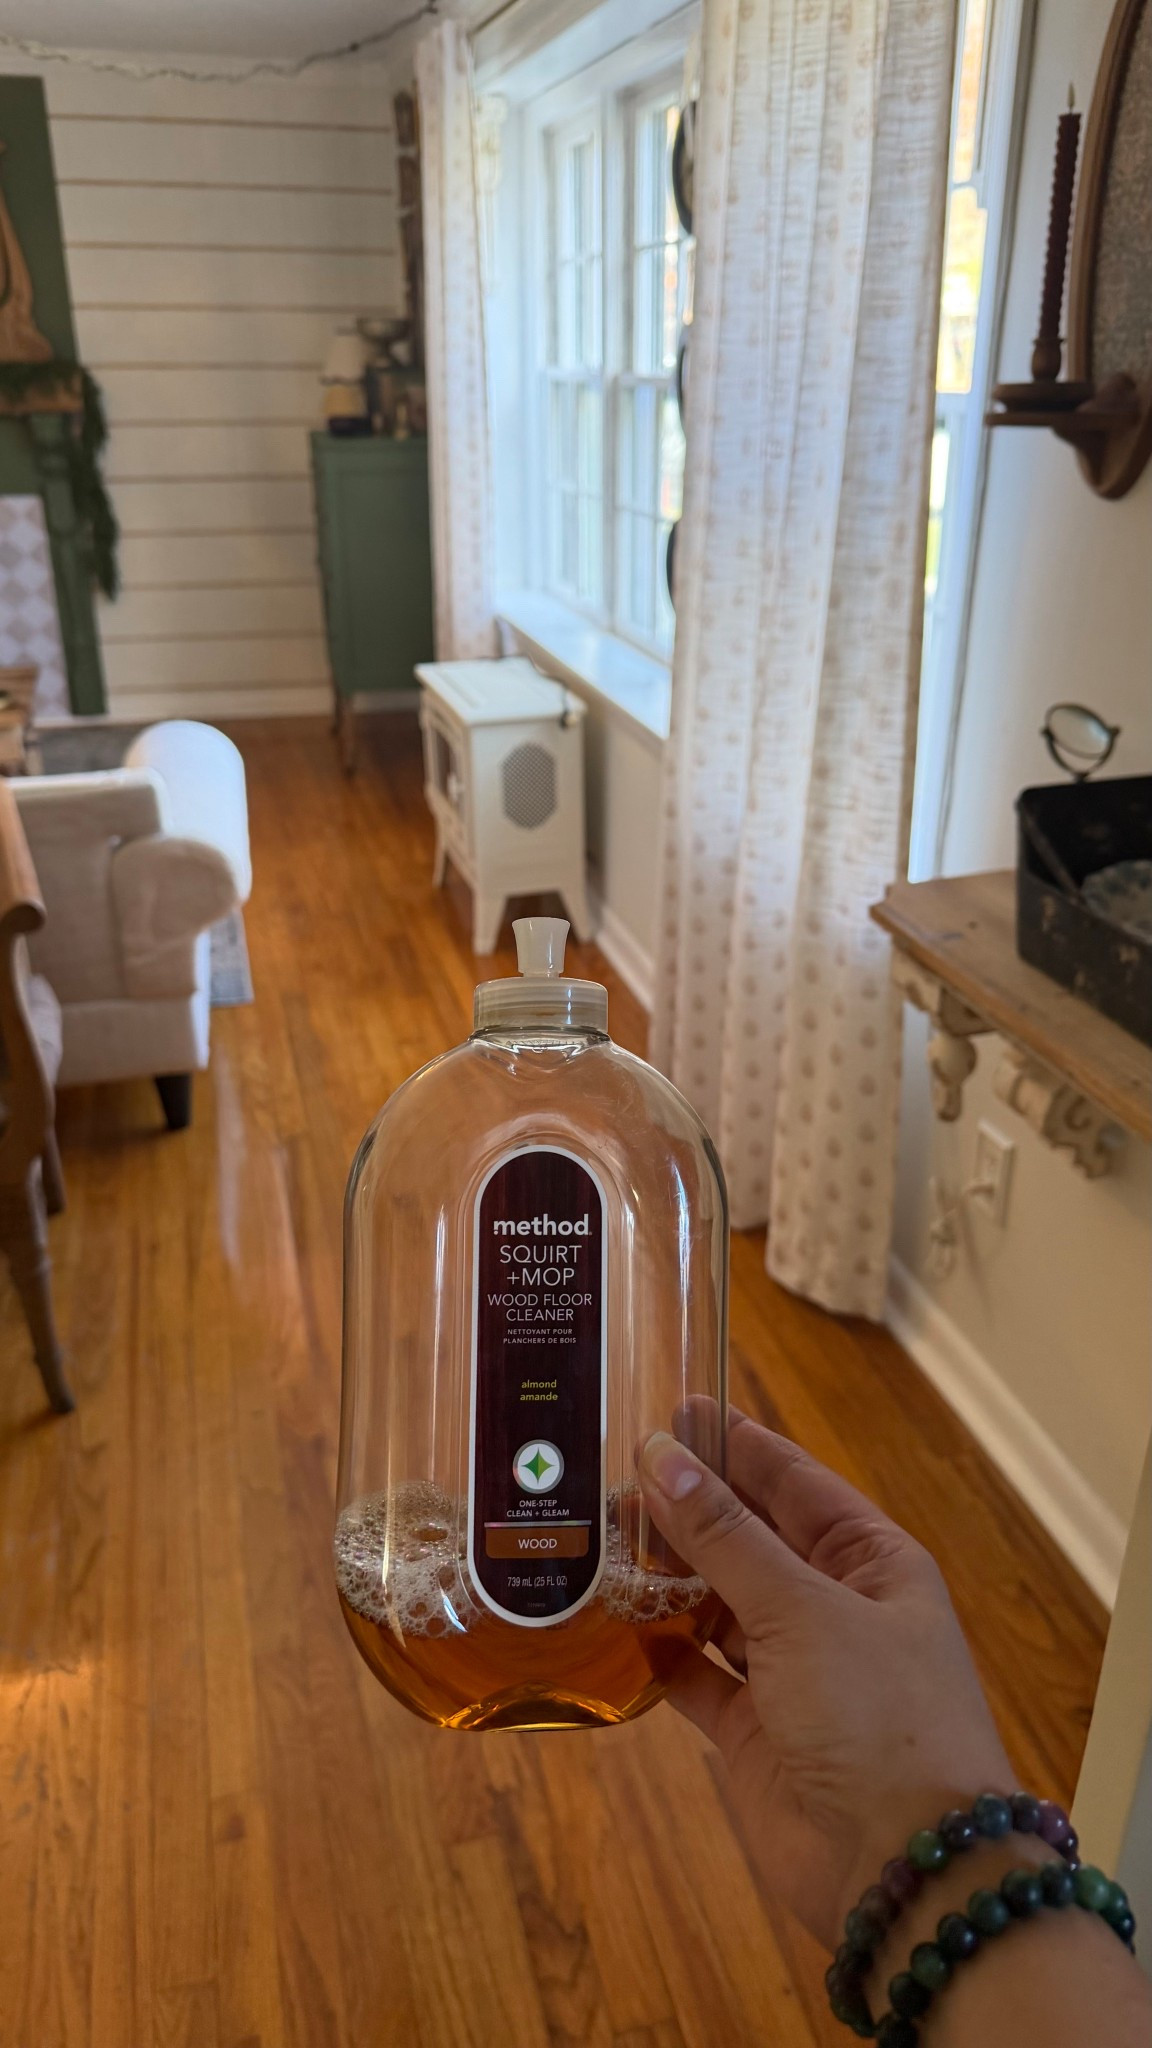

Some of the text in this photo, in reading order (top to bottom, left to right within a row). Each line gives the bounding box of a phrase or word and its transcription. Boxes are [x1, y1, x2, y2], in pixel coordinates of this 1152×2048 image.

[499, 1245, 582, 1264] SQUIRT
[506, 1267, 576, 1286] +MOP
[487, 1294, 593, 1307] WOOD FLOOR
[506, 1308, 575, 1322] CLEANER
[521, 1379, 557, 1389] almond
[520, 1391, 559, 1401] amande
[519, 1499, 558, 1507] ONE-STEP
[506, 1509, 533, 1518] CLEAN
[541, 1508, 570, 1517] GLEAM
[518, 1538, 557, 1549] WOOD
[507, 1575, 567, 1588] 739 mL (25 FL OZ)
